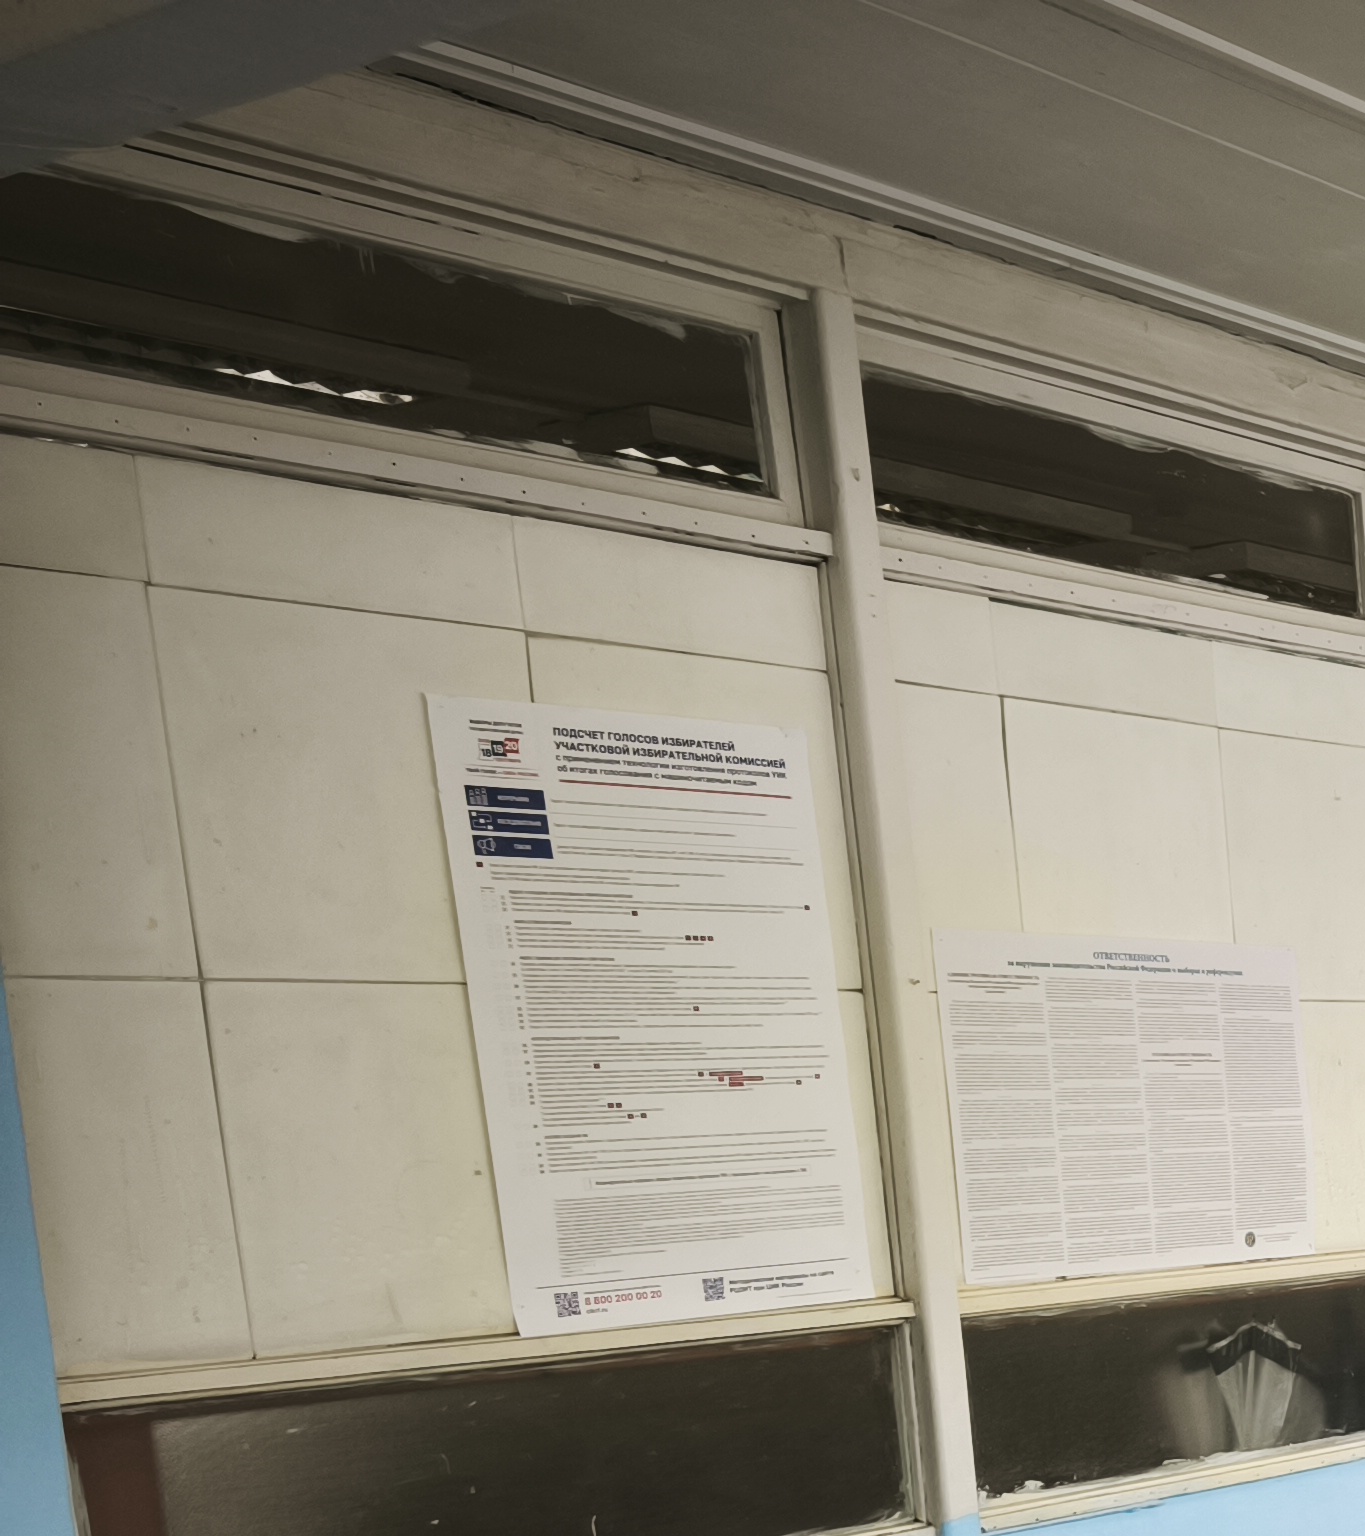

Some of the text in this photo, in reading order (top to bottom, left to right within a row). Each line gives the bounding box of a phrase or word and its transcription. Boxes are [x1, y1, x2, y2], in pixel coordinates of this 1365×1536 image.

[481, 741, 518, 757] 18 19 20
[552, 727, 735, 751] ПОДСЧЕТ ГОЛОСОВ ИЗБИРАТЕЛЕЙ
[554, 741, 630, 755] УЧАСТКОВОЙ
[632, 747, 723, 763] ИЗБИРАТЕЛЬНОЙ
[725, 755, 786, 769] КОМИССИЕЙ
[615, 1293, 633, 1303] 200
[635, 1291, 648, 1300] 00
[650, 1290, 662, 1299] 20
